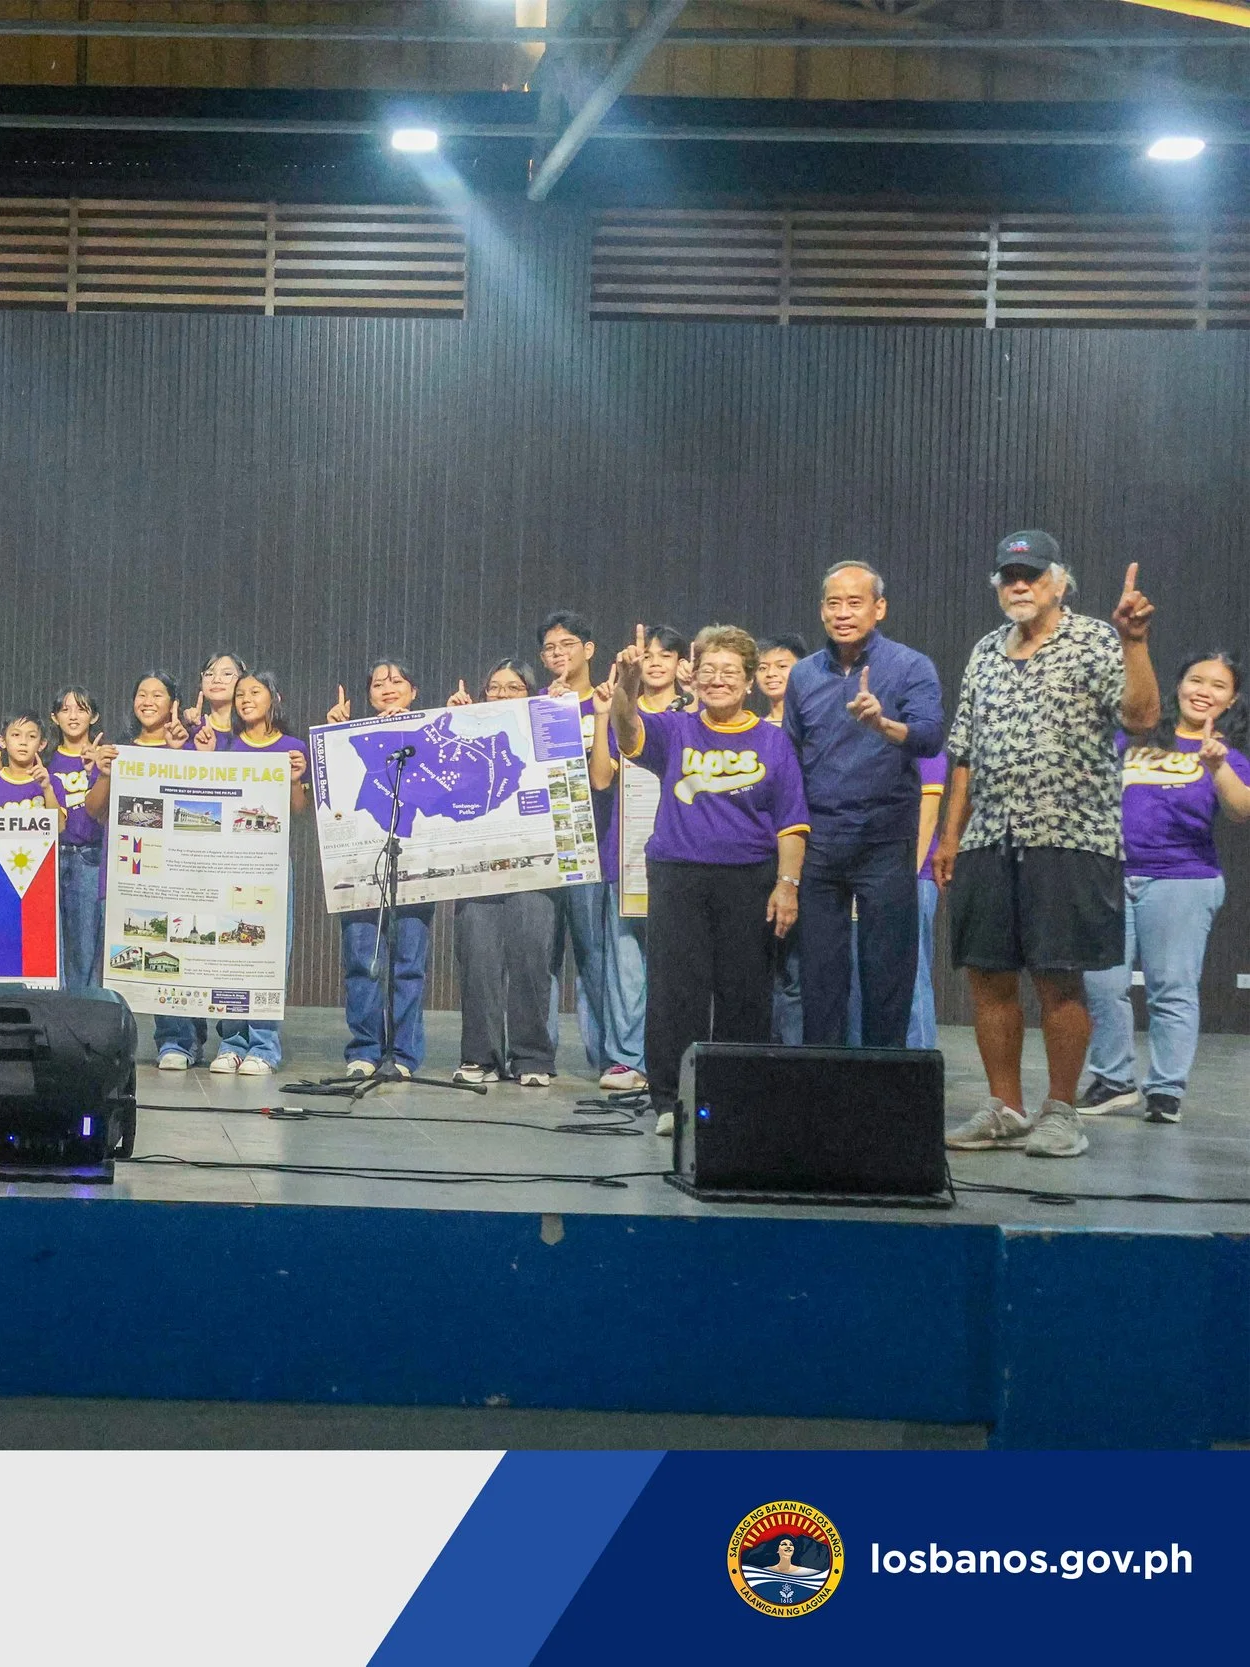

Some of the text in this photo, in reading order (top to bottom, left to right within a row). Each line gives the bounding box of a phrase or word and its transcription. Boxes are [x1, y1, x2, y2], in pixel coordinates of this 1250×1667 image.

[316, 733, 325, 765] LAKBAY
[117, 760, 285, 782] THE PHILIPPINE FLAG
[9, 817, 51, 832] FLAG
